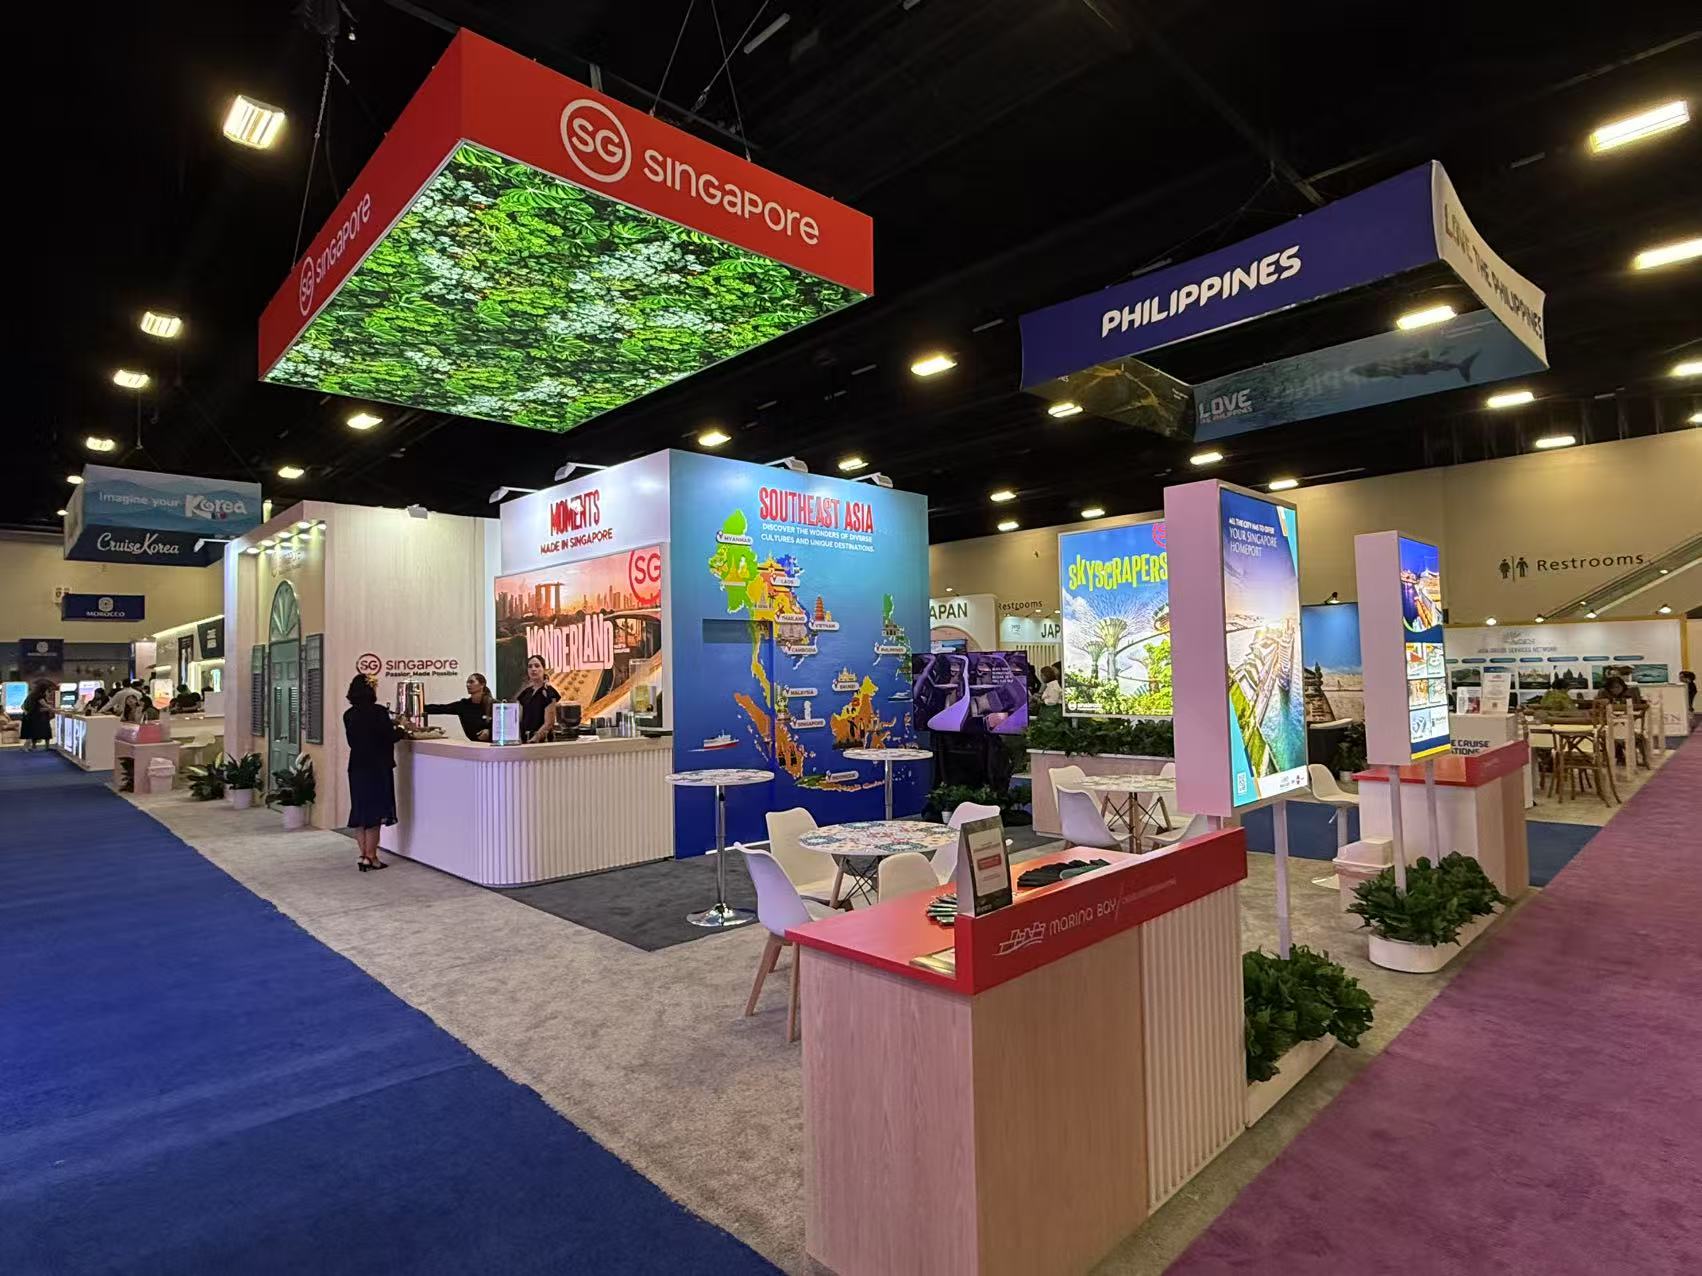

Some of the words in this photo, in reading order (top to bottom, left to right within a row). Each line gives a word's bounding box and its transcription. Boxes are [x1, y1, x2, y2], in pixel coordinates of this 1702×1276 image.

[1102, 245, 1302, 339] PHILIPPINES
[1199, 389, 1251, 418] LOVE
[99, 491, 149, 506] Imagine
[152, 498, 180, 508] your
[185, 494, 248, 520] Korea
[758, 487, 840, 529] SOUTHEAST
[844, 501, 874, 533] ASIA
[540, 540, 560, 555] MADE
[561, 538, 569, 550] IN
[570, 528, 613, 548] SINGAPORE
[760, 533, 795, 544] CULTURES
[795, 537, 810, 545] AND
[810, 539, 834, 548] UNIQUE
[762, 523, 795, 533] DISCOVER
[796, 527, 809, 535] THE
[809, 529, 840, 539] WONDERS
[840, 532, 849, 540] OF
[849, 533, 873, 543] DIVERSE
[1229, 527, 1246, 541] YOUR
[634, 553, 661, 584] SG
[1068, 552, 1168, 592] SKYSCRAPERS
[1537, 552, 1644, 572] Restrooms
[930, 602, 968, 620] APAN
[526, 613, 614, 674] WONDERLAND
[1041, 623, 1060, 639] JAP
